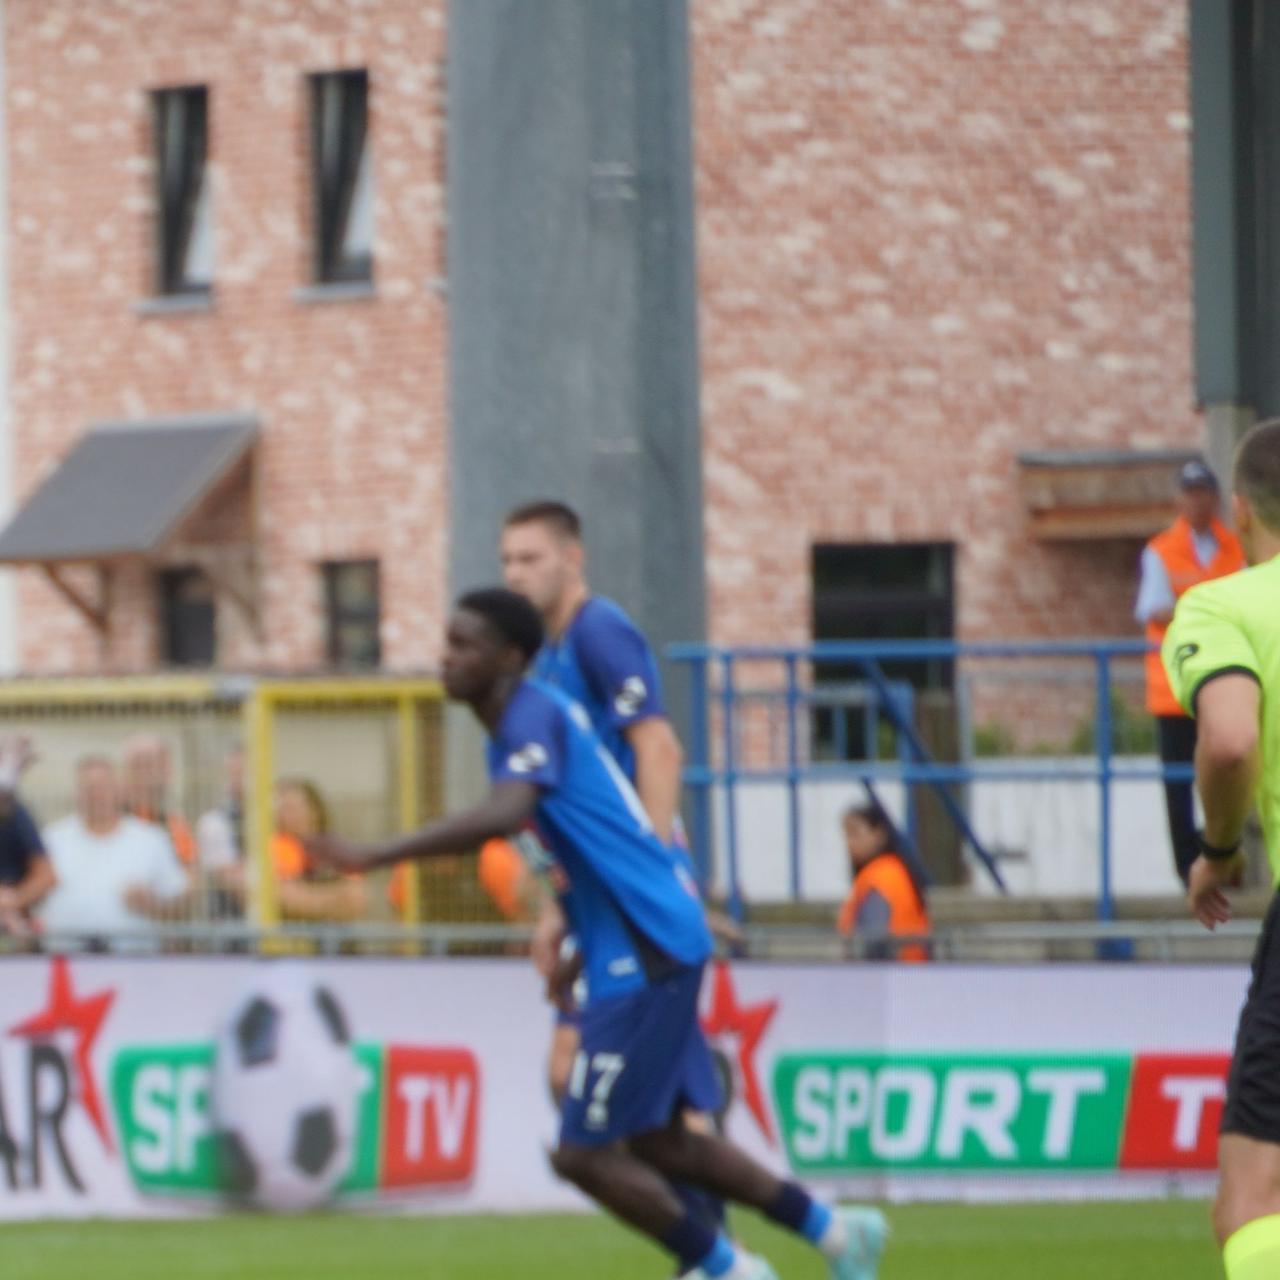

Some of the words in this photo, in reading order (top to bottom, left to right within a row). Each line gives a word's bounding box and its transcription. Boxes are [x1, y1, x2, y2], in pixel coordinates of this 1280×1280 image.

[397, 1073, 471, 1162] TV
[569, 1052, 625, 1101] 17
[792, 1064, 1107, 1160] SPORT
[1160, 1075, 1225, 1152] T
